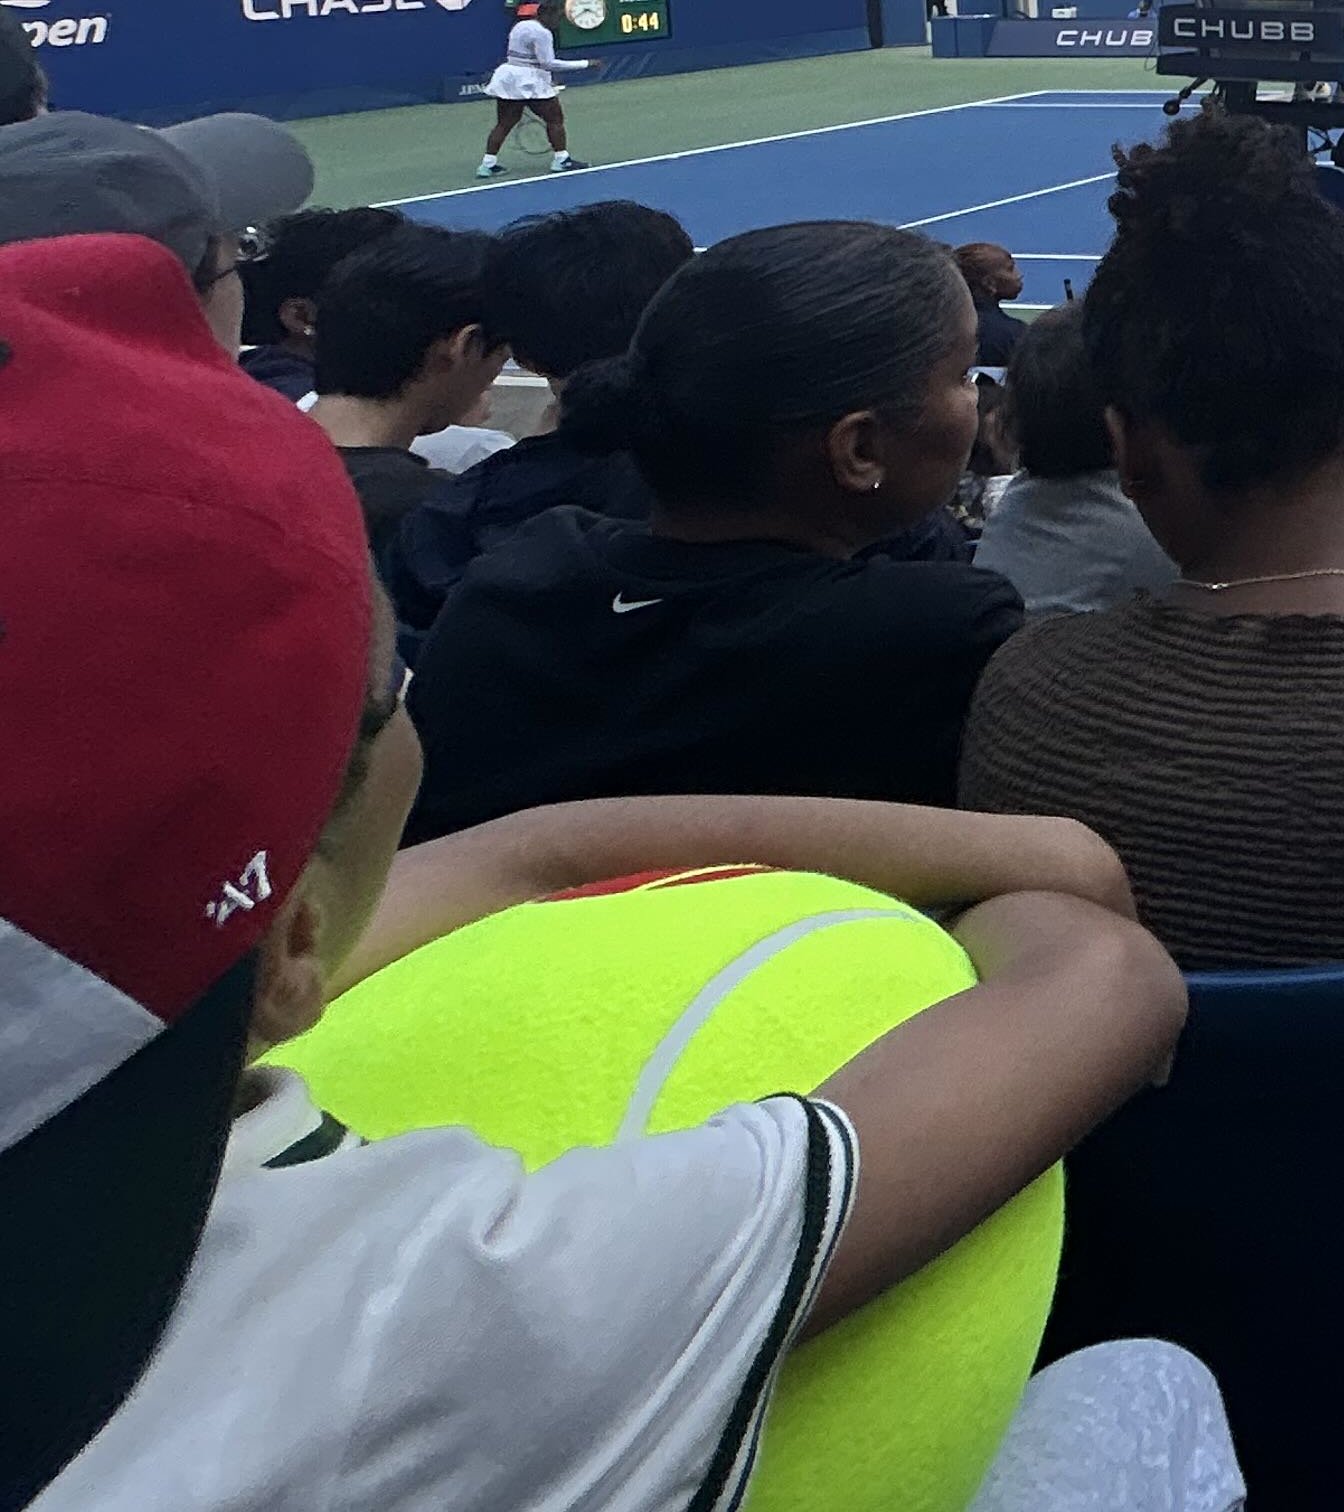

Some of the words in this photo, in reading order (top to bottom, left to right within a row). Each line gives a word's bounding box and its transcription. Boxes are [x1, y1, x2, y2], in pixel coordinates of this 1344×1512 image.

[22, 14, 107, 48] pen
[1056, 30, 1153, 47] CHUB
[1173, 18, 1314, 41] CHUBB
